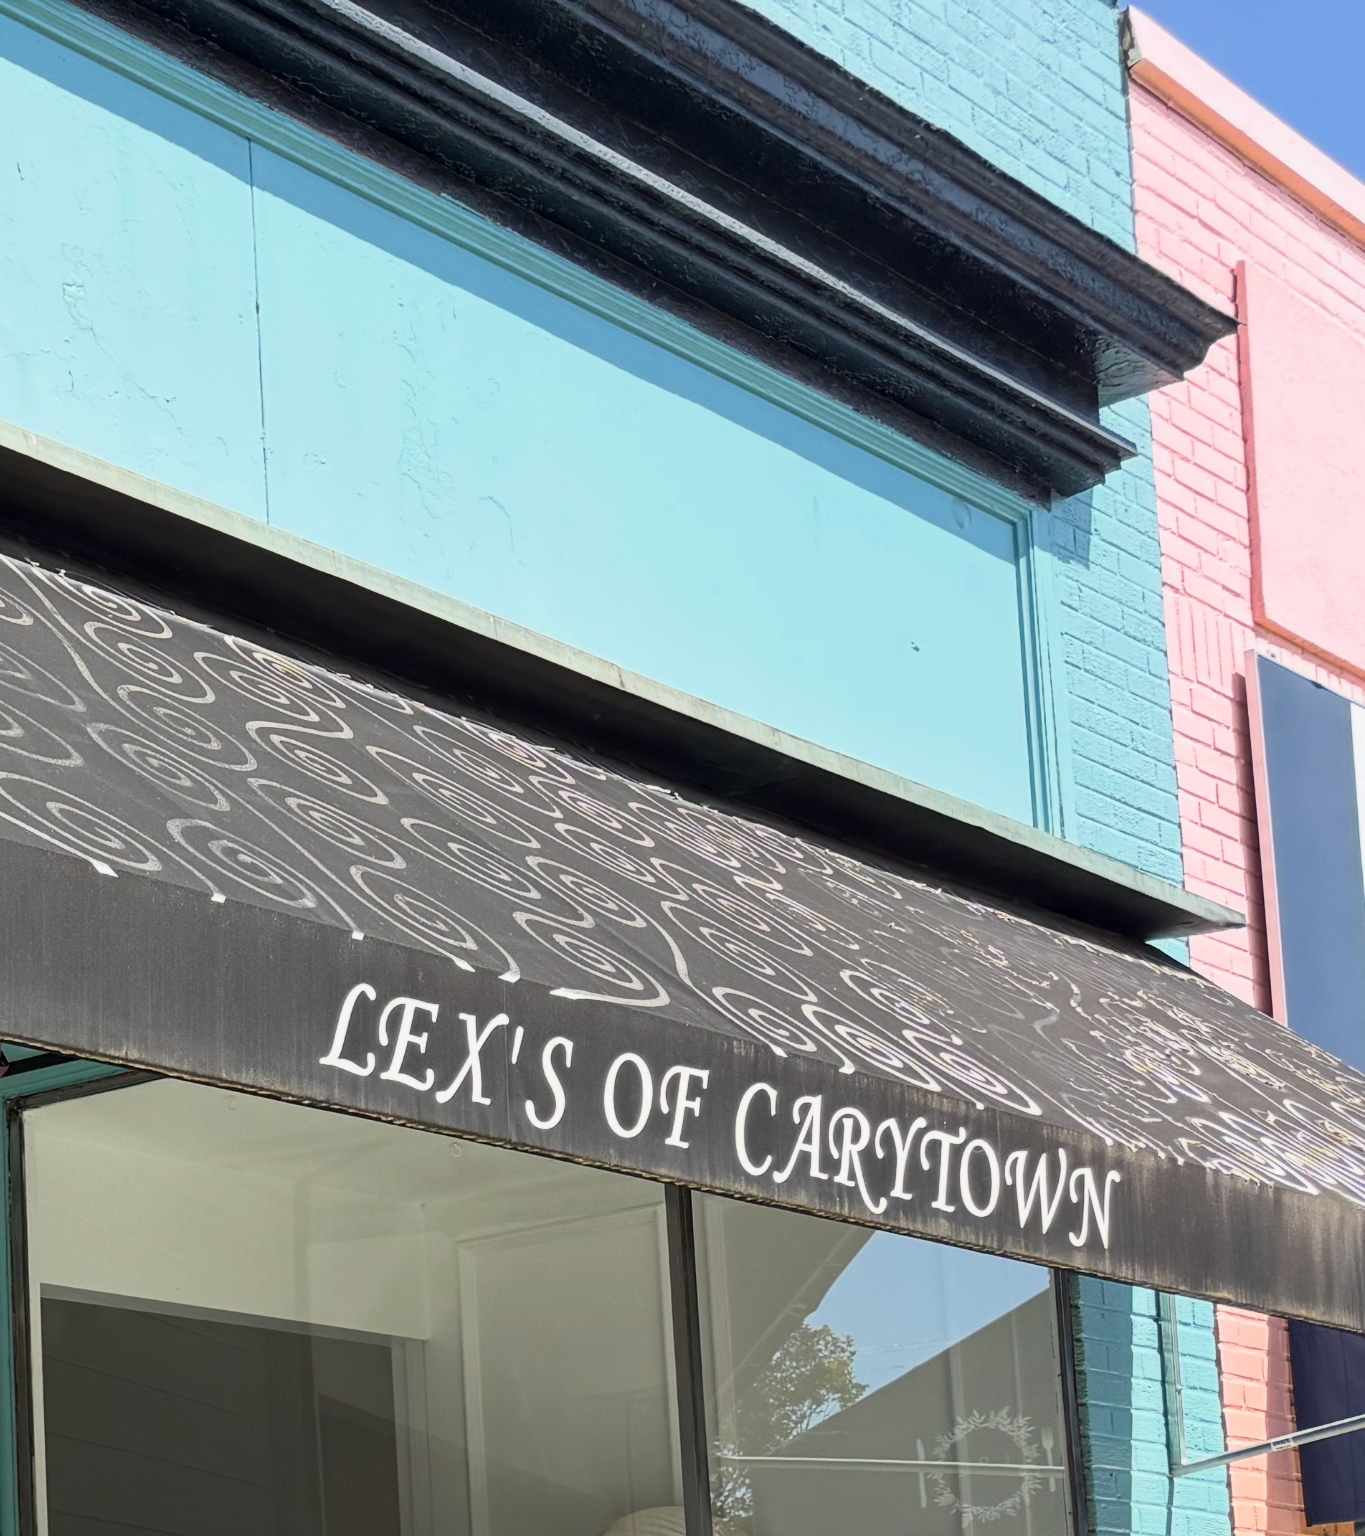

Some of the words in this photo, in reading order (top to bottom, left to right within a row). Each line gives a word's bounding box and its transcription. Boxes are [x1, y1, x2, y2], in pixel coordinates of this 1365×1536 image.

[319, 982, 574, 1130] LEX'S
[603, 1052, 710, 1149] OF
[735, 1082, 1121, 1250] CARYTOWN
